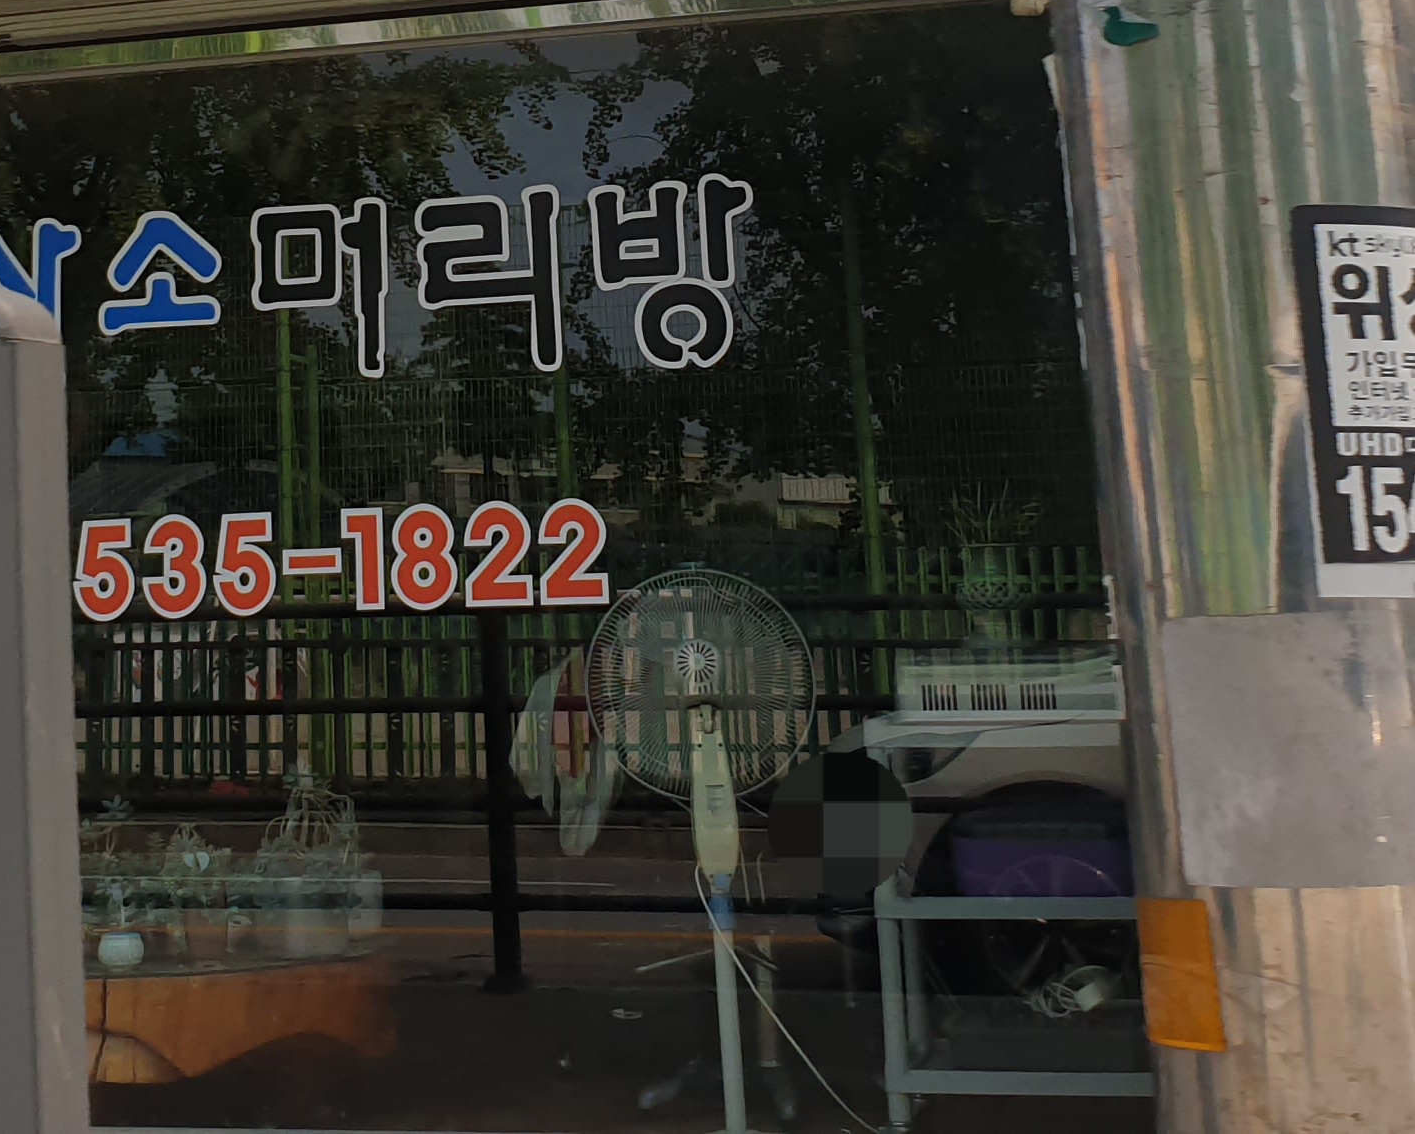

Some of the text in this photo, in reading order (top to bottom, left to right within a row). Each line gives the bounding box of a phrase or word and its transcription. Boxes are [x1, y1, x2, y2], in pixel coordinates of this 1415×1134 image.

[1330, 263, 1415, 341] 위
[1348, 405, 1415, 421] 추가가입
[72, 498, 611, 623] 535-1822
